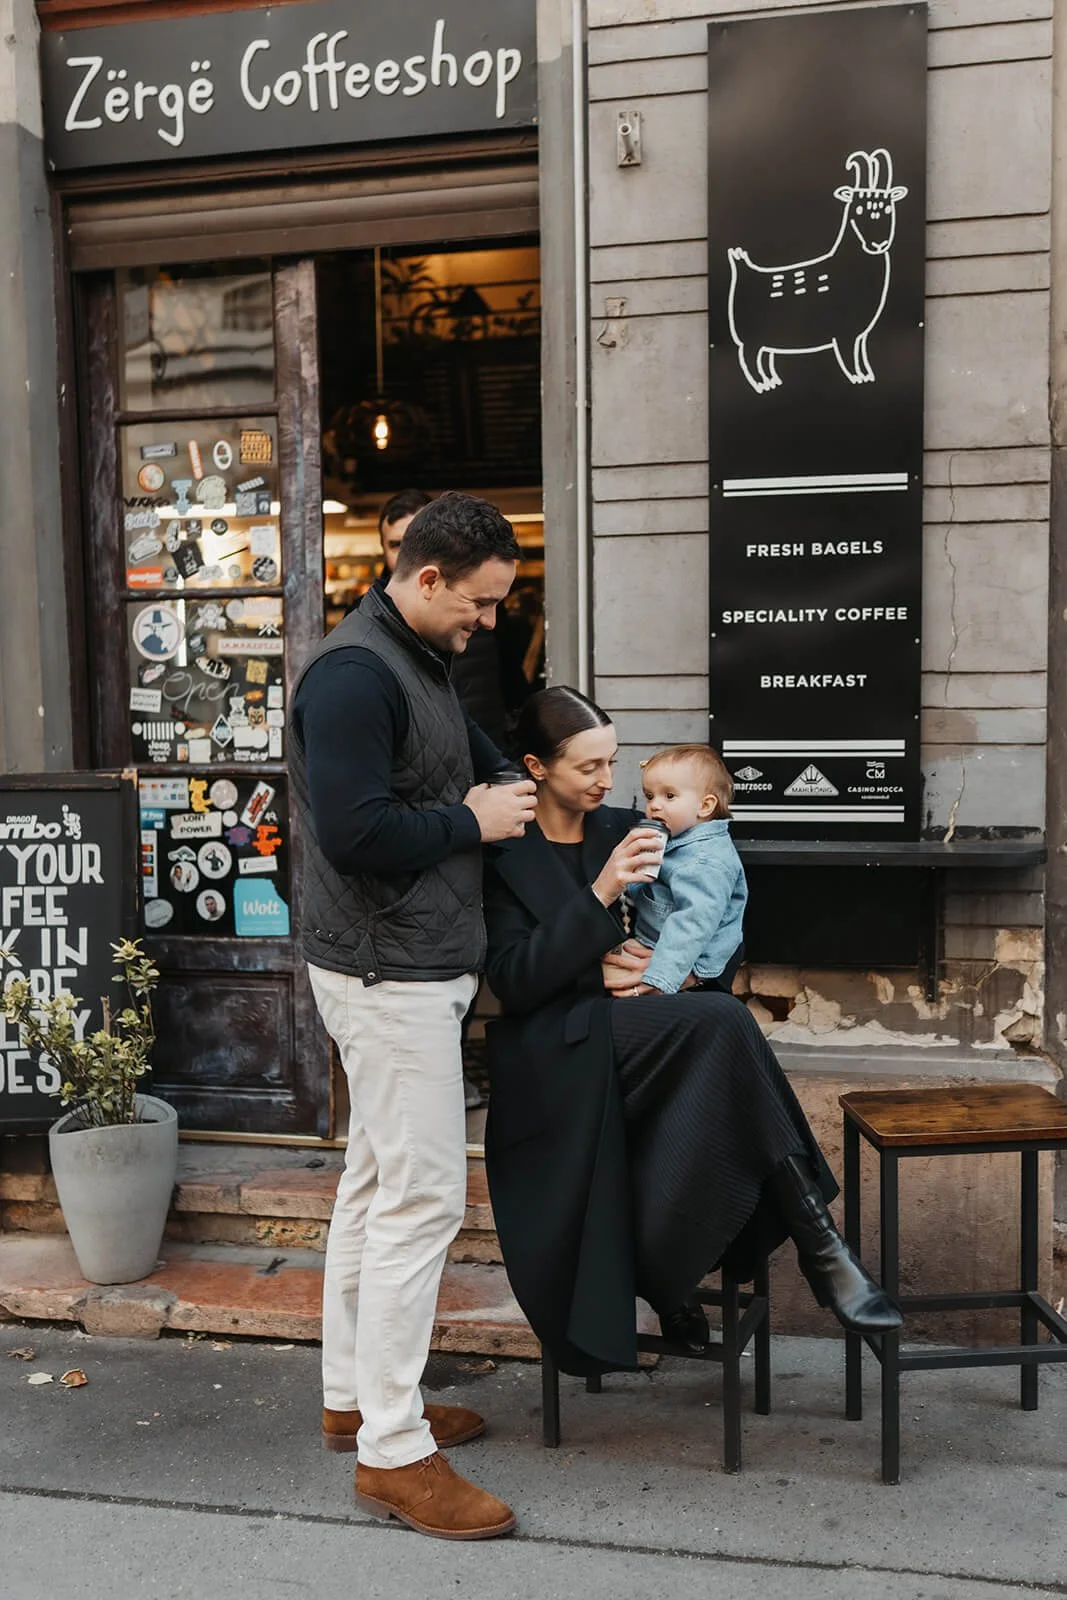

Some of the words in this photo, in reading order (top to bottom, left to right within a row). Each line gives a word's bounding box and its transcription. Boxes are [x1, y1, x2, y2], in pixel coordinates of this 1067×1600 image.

[65, 56, 214, 147] Zërgë
[240, 19, 522, 119] Coffeeshop
[746, 543, 804, 557] FRESH
[811, 540, 883, 555] BAGELS
[722, 608, 828, 624] SPECIALITY
[835, 607, 907, 621] COFFEE
[760, 674, 867, 688] BREAKFAST
[0, 814, 62, 839] mbo
[6, 815, 31, 824] DRAGO
[6, 843, 105, 885] YOUR
[242, 898, 281, 916] Wolt
[41, 927, 88, 966] IN
[0, 1050, 61, 1094] ES
